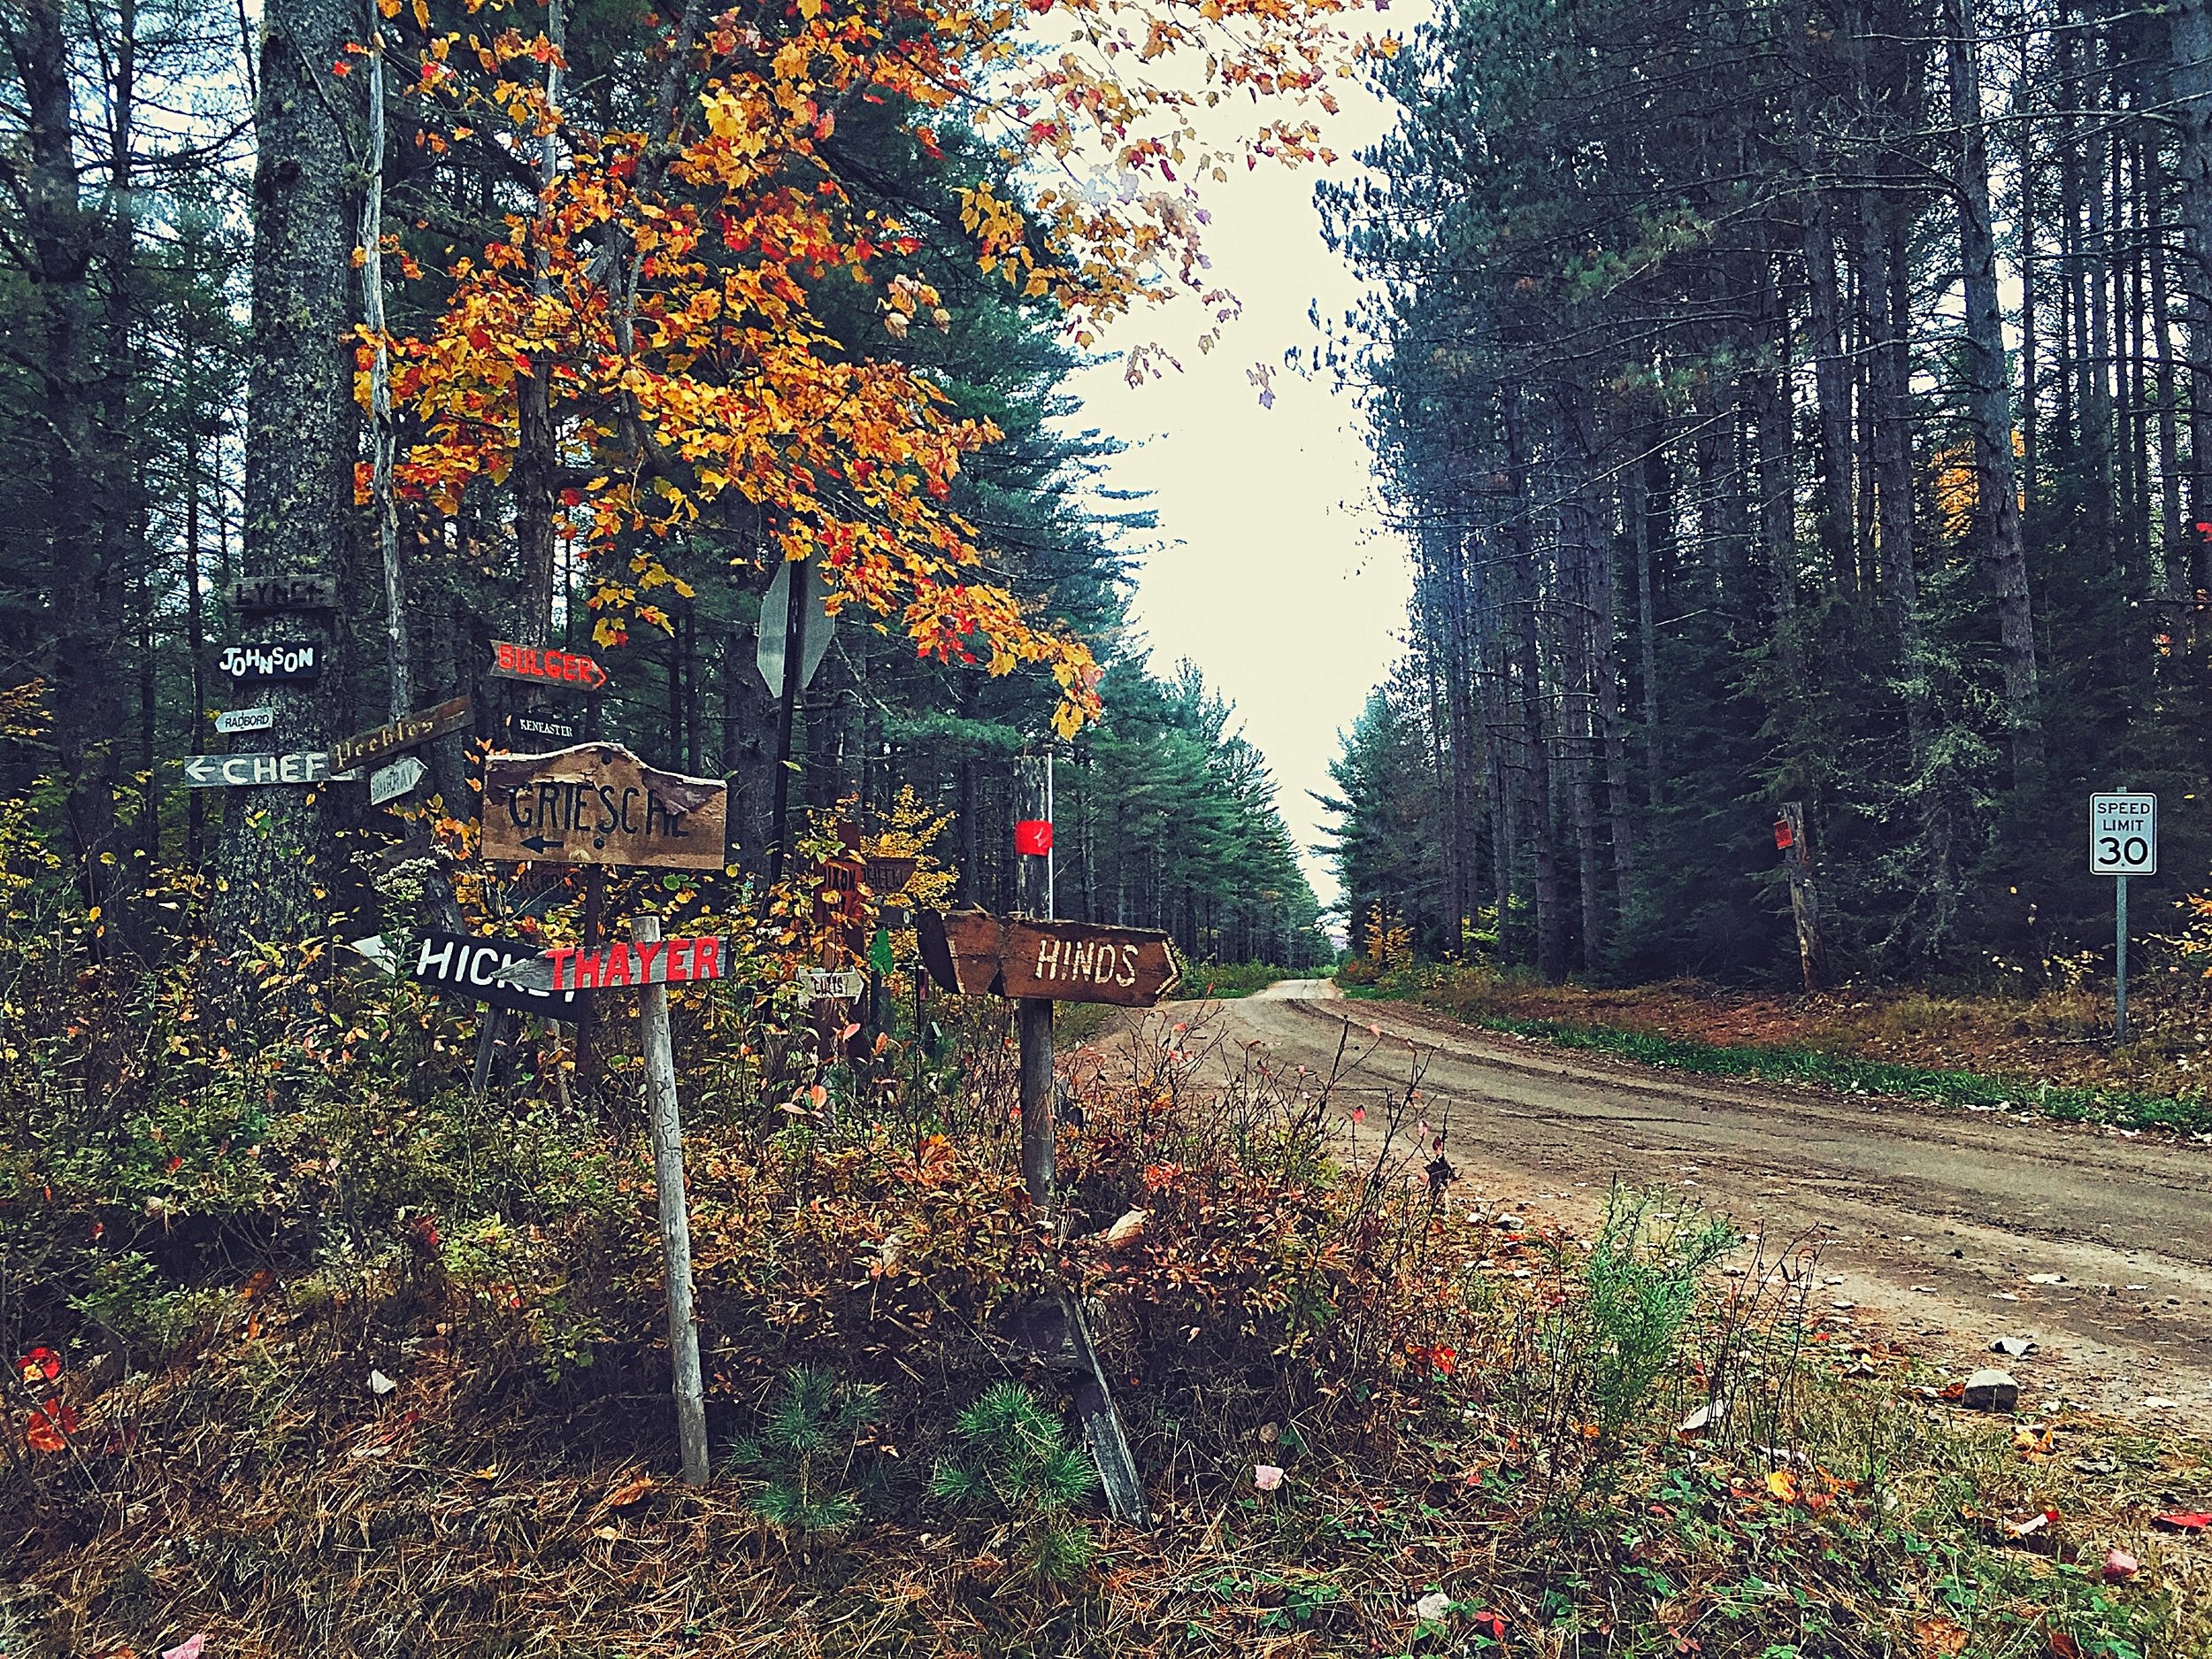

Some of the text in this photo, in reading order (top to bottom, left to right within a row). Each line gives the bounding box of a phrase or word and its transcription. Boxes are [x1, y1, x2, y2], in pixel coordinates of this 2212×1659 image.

[219, 648, 313, 676] JOHNSON
[498, 644, 593, 682] BULGER
[520, 718, 573, 737] KENEASTER
[2097, 803, 2151, 815] SPEED
[2102, 819, 2145, 832] LIMIT
[2097, 836, 2148, 865] 30
[418, 939, 575, 1002] HICK
[545, 937, 720, 990] THAYER
[1035, 939, 1138, 987] HINDS
